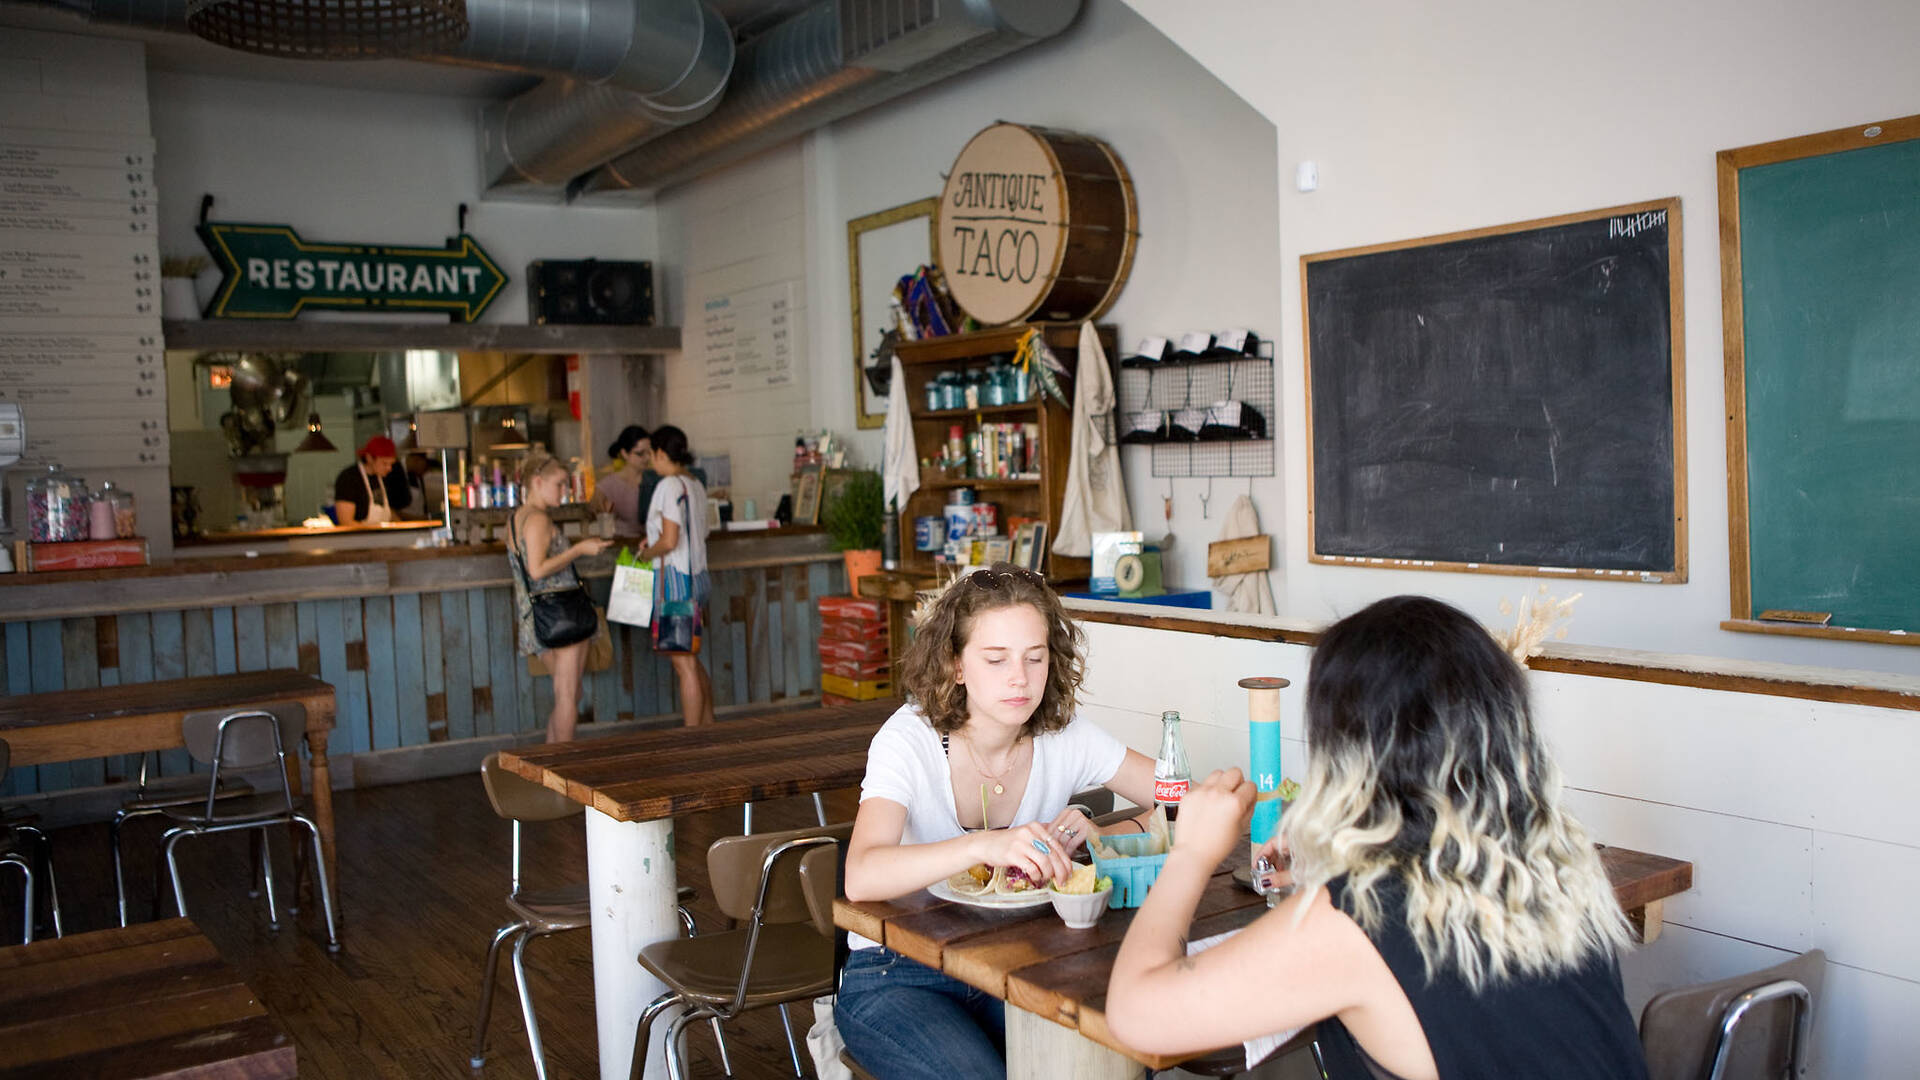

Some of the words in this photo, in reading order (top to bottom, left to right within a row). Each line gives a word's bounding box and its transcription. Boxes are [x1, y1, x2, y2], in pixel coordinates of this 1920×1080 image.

[953, 172, 1046, 212] ANTIQUE
[954, 226, 1039, 284] TACO
[248, 257, 482, 294] RESTAURANT
[1259, 773, 1273, 790] 14
